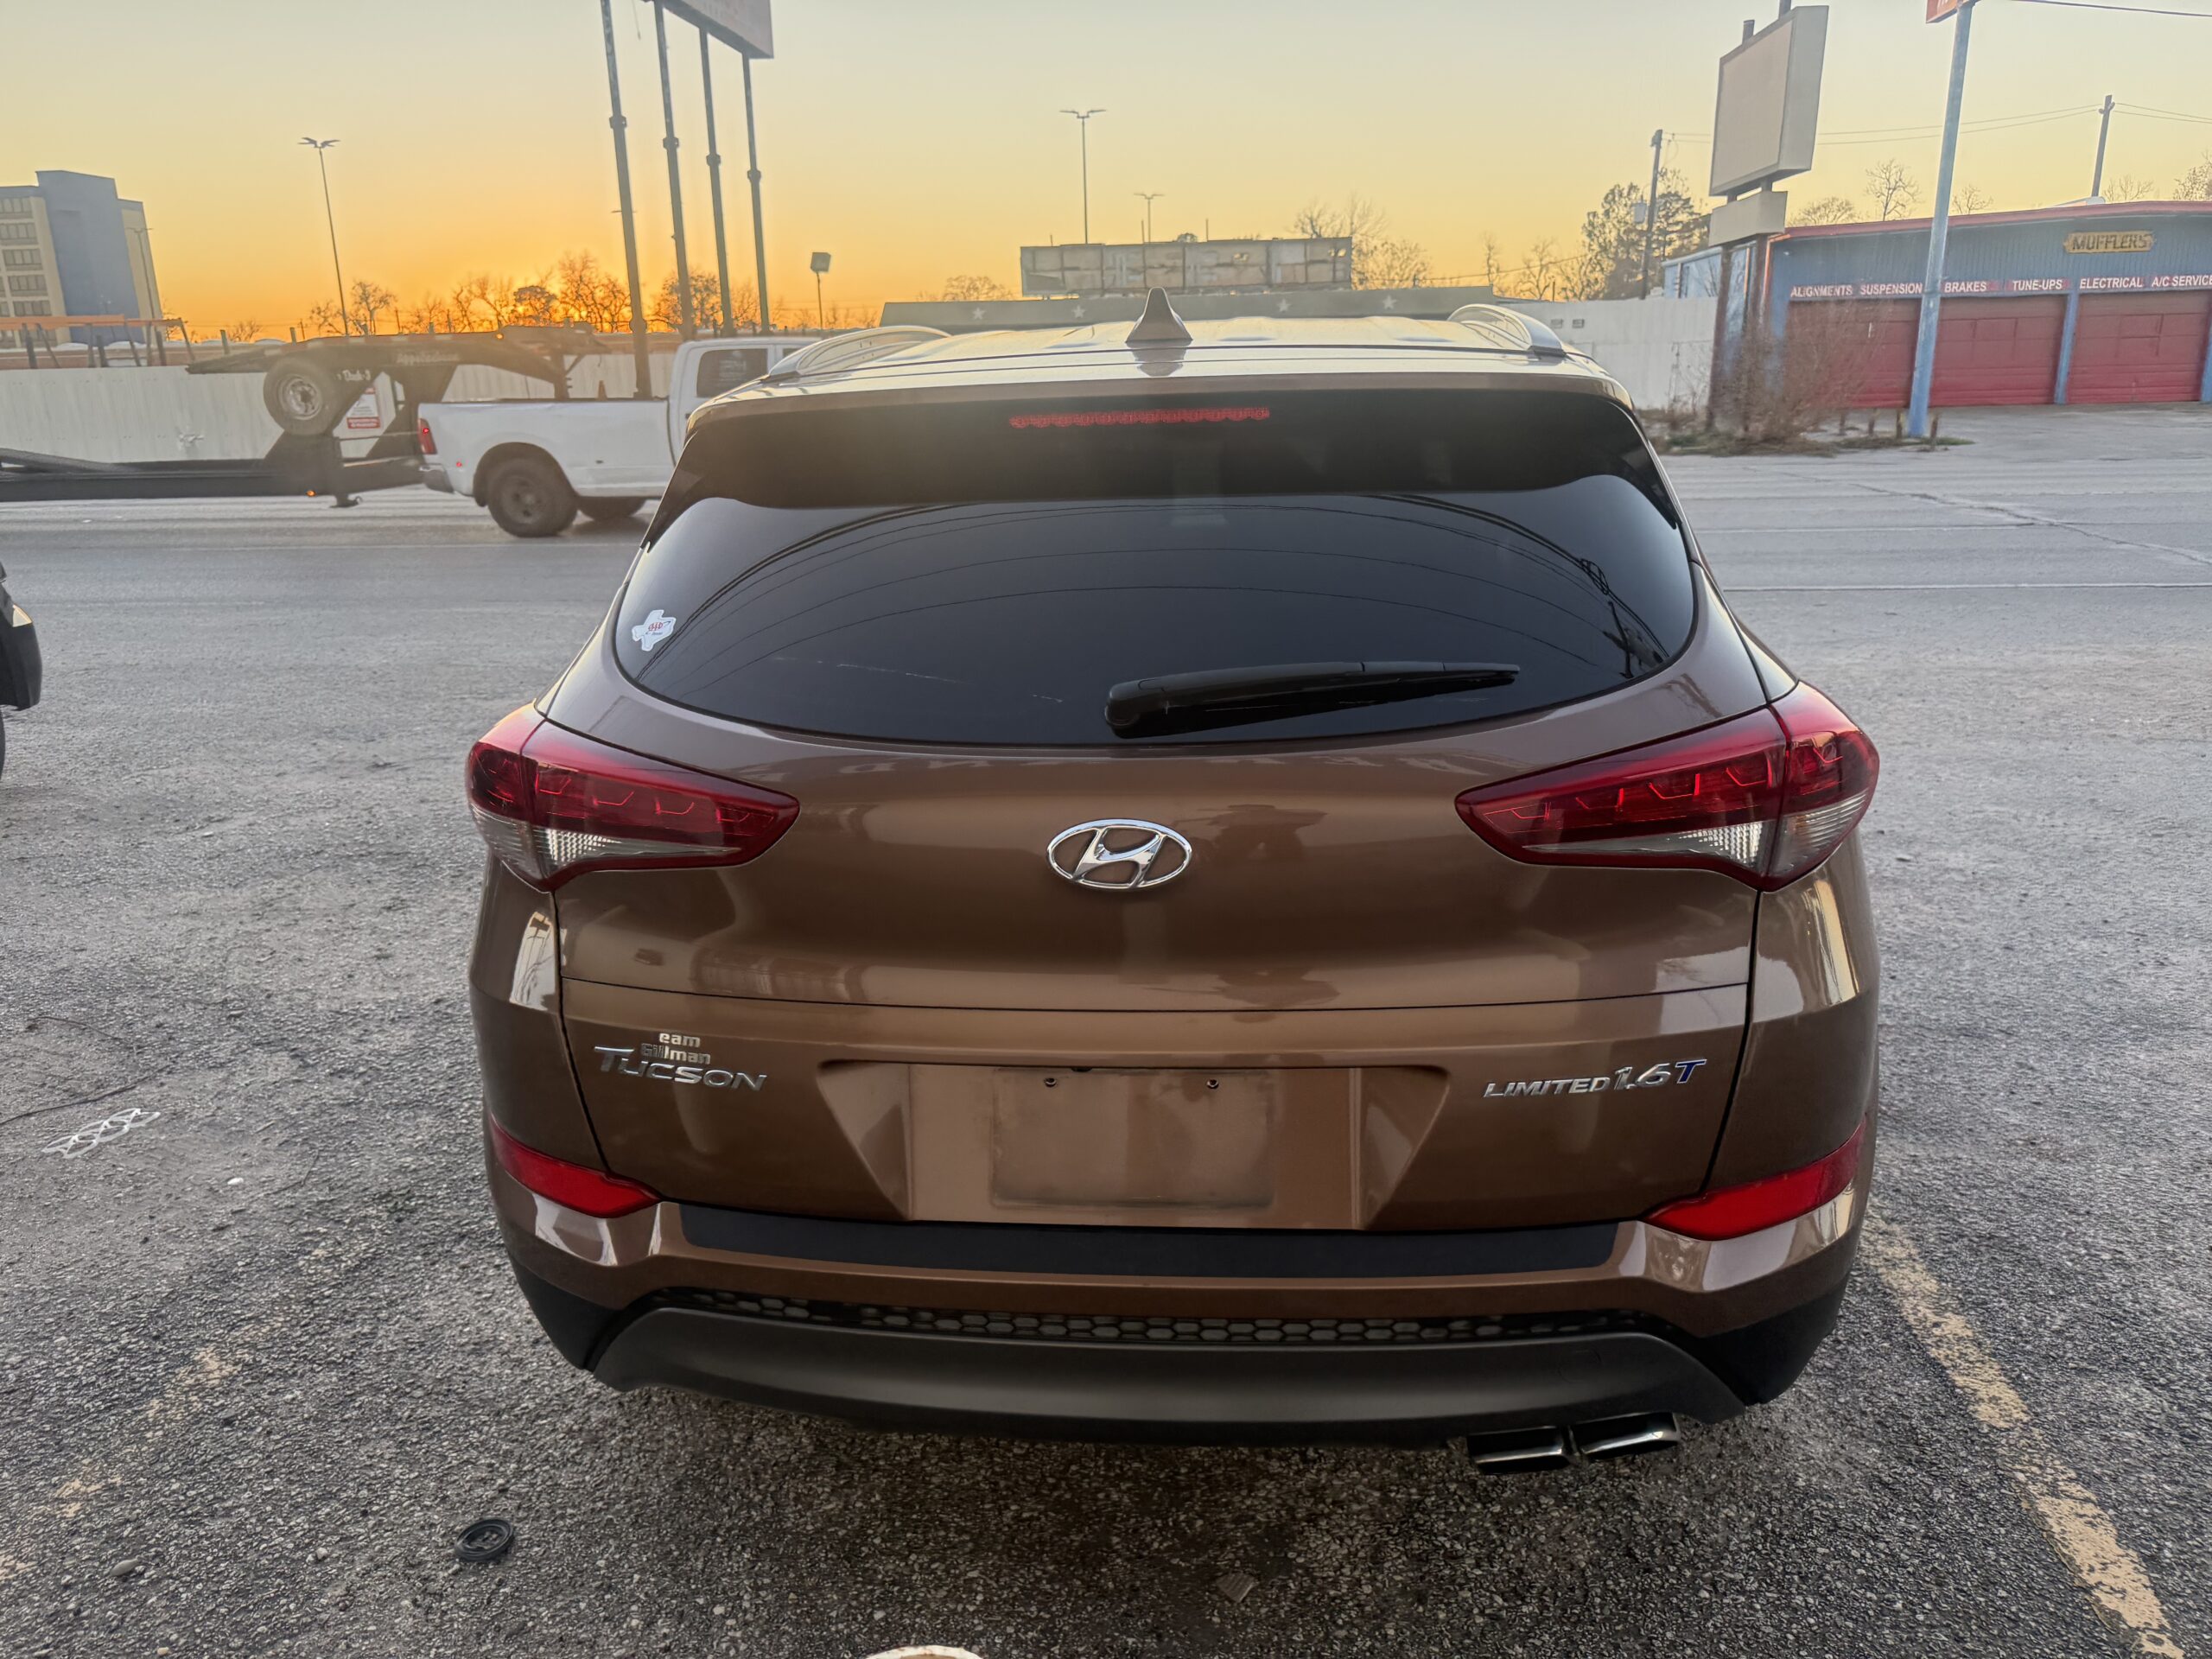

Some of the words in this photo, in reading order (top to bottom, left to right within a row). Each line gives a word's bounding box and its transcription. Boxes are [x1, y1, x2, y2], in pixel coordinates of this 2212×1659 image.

[2073, 234, 2148, 250] MUFFLERS
[1790, 284, 1853, 298] ALIGNMENTS
[1859, 283, 1923, 296] SUSPENSION
[1944, 281, 1987, 293] BRAKES
[2012, 278, 2063, 291] TUNE-UPS
[2080, 276, 2143, 289] ELECTRICAL
[2152, 276, 2170, 288] A/C
[641, 1043, 711, 1065] Gillman
[1484, 1077, 1611, 1097] LIMITED
